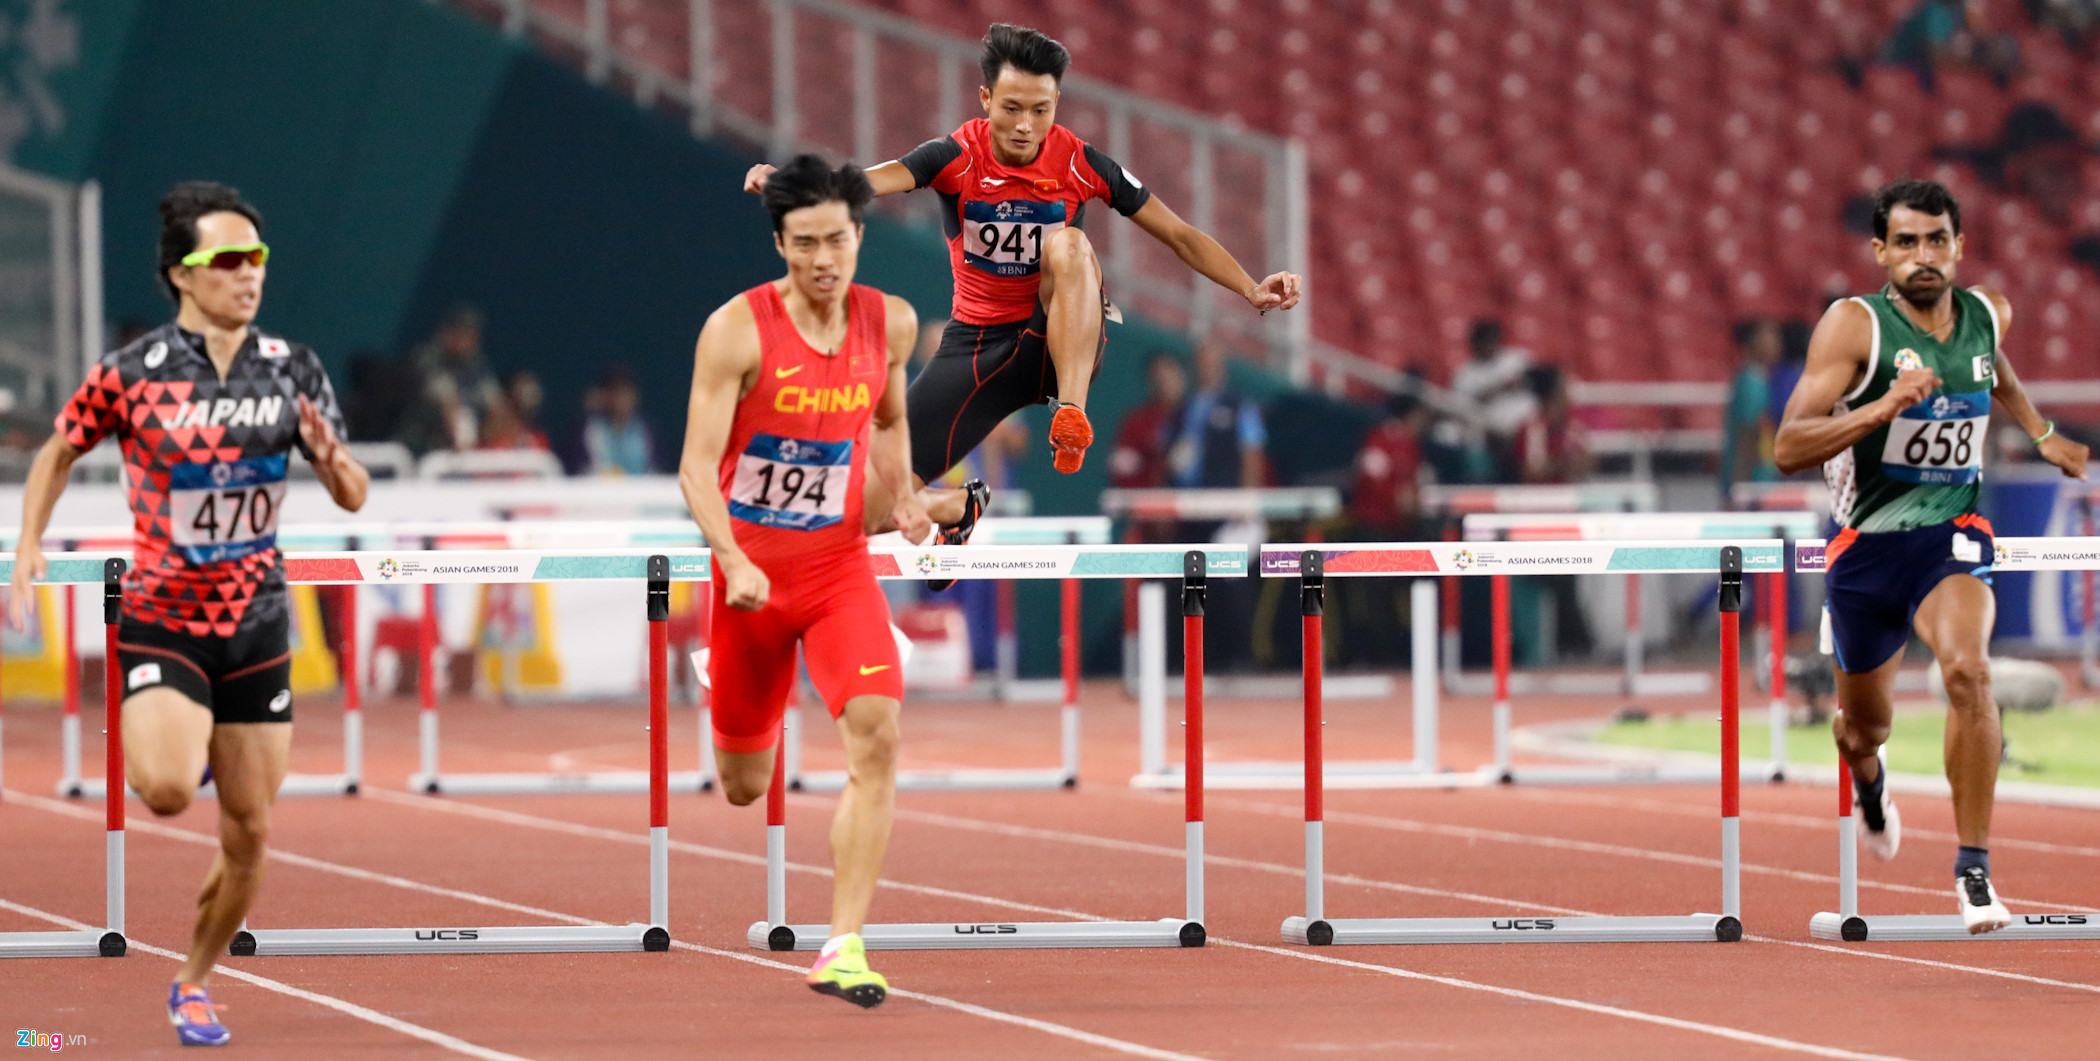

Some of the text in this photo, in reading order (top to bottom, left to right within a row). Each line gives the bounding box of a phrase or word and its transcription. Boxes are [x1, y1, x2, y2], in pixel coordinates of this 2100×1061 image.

[979, 224, 1042, 263] 941
[1008, 266, 1026, 275] BNI
[774, 383, 870, 412] CHINA
[162, 395, 283, 430] JAPAN
[1904, 420, 1974, 466] 658
[752, 462, 828, 512] 194
[192, 488, 272, 540] 470
[1266, 560, 1300, 568] UCS
[1492, 920, 1554, 930] UCS
[2024, 915, 2087, 924] UCS
[416, 930, 478, 940] UCS
[954, 925, 1017, 934] UCS
